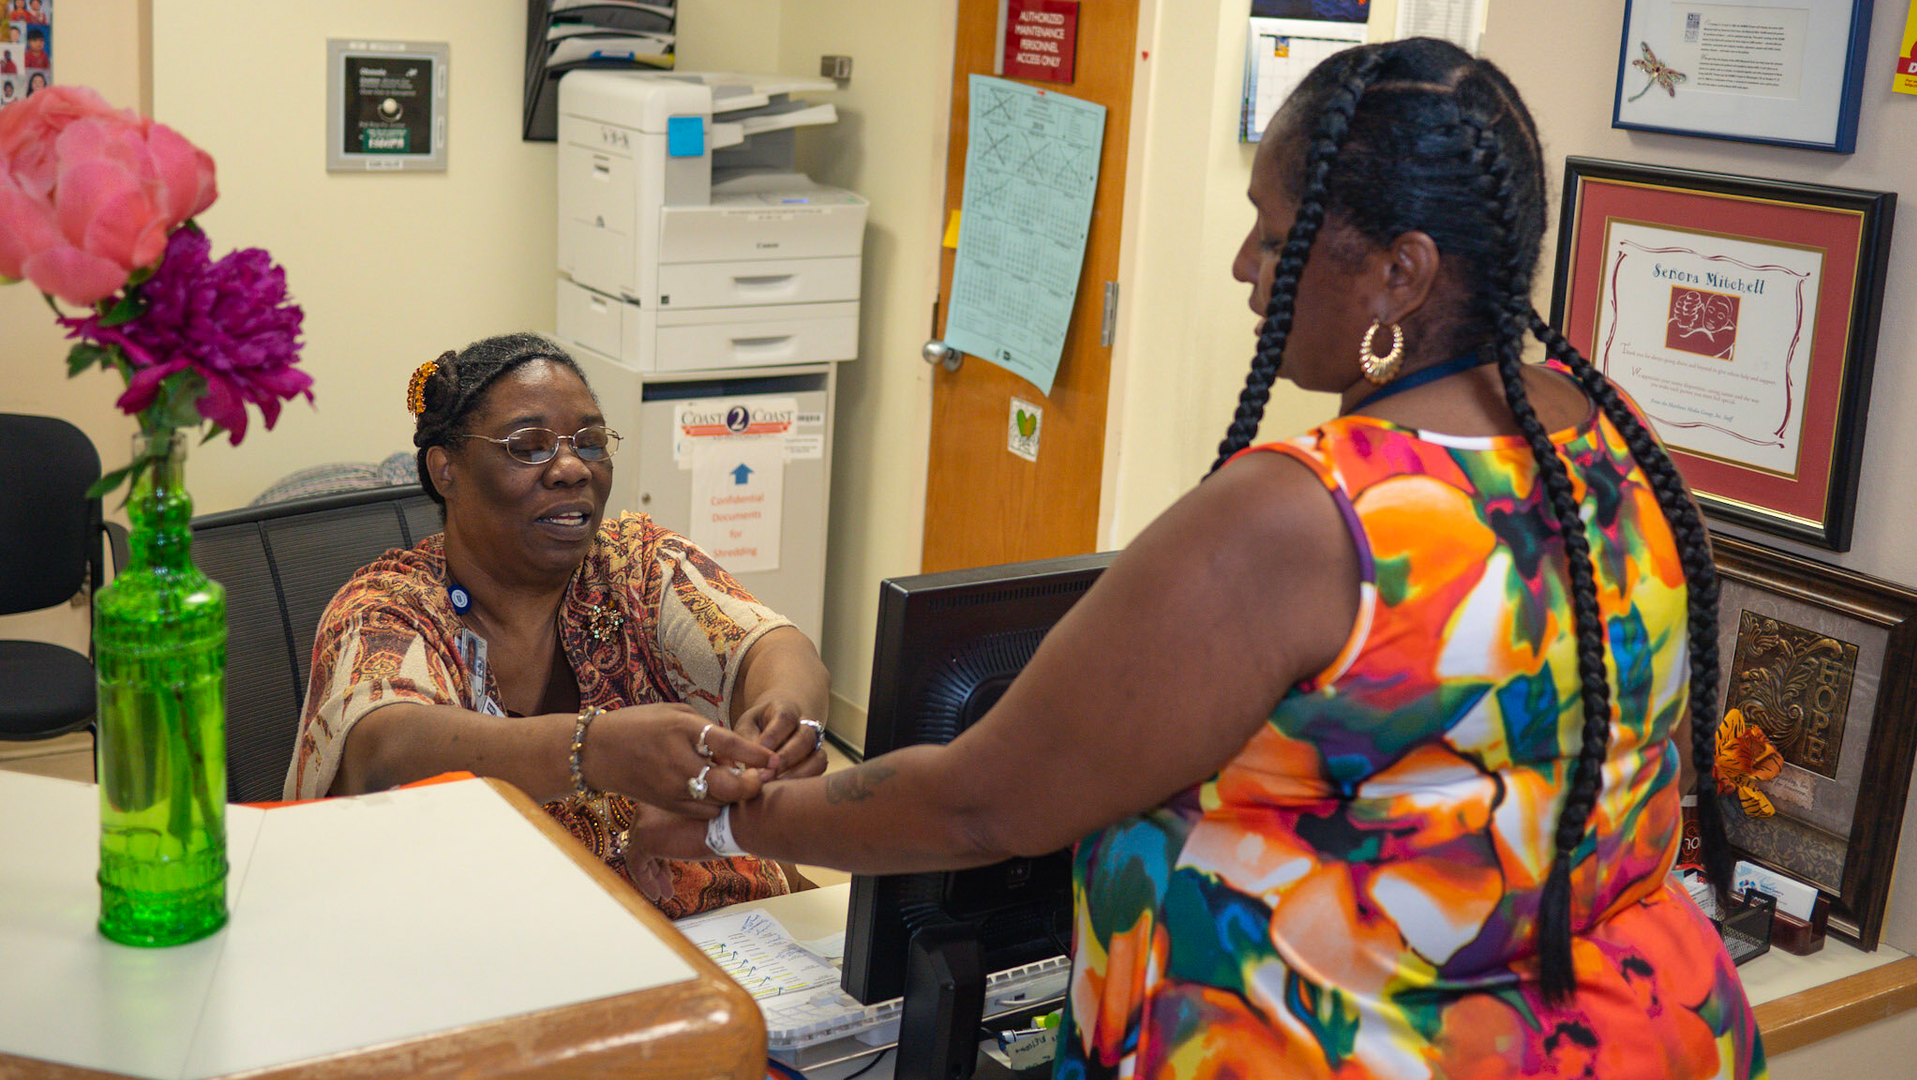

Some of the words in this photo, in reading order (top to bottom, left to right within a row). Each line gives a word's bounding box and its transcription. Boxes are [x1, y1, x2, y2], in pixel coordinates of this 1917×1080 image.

[1019, 10, 1065, 25] AUTHORIZED
[1014, 24, 1066, 40] MAINTENANCE
[1020, 38, 1059, 53] PERSONNEL
[1016, 52, 1041, 65] ACCESS
[1041, 54, 1062, 68] ONLY
[1706, 271, 1765, 295] Mitchell
[727, 405, 750, 432] 2
[710, 492, 765, 507] Confidential
[711, 510, 762, 523] Documents
[728, 529, 743, 539] for
[713, 546, 758, 559] Shredding
[1803, 655, 1844, 768] HOPE
